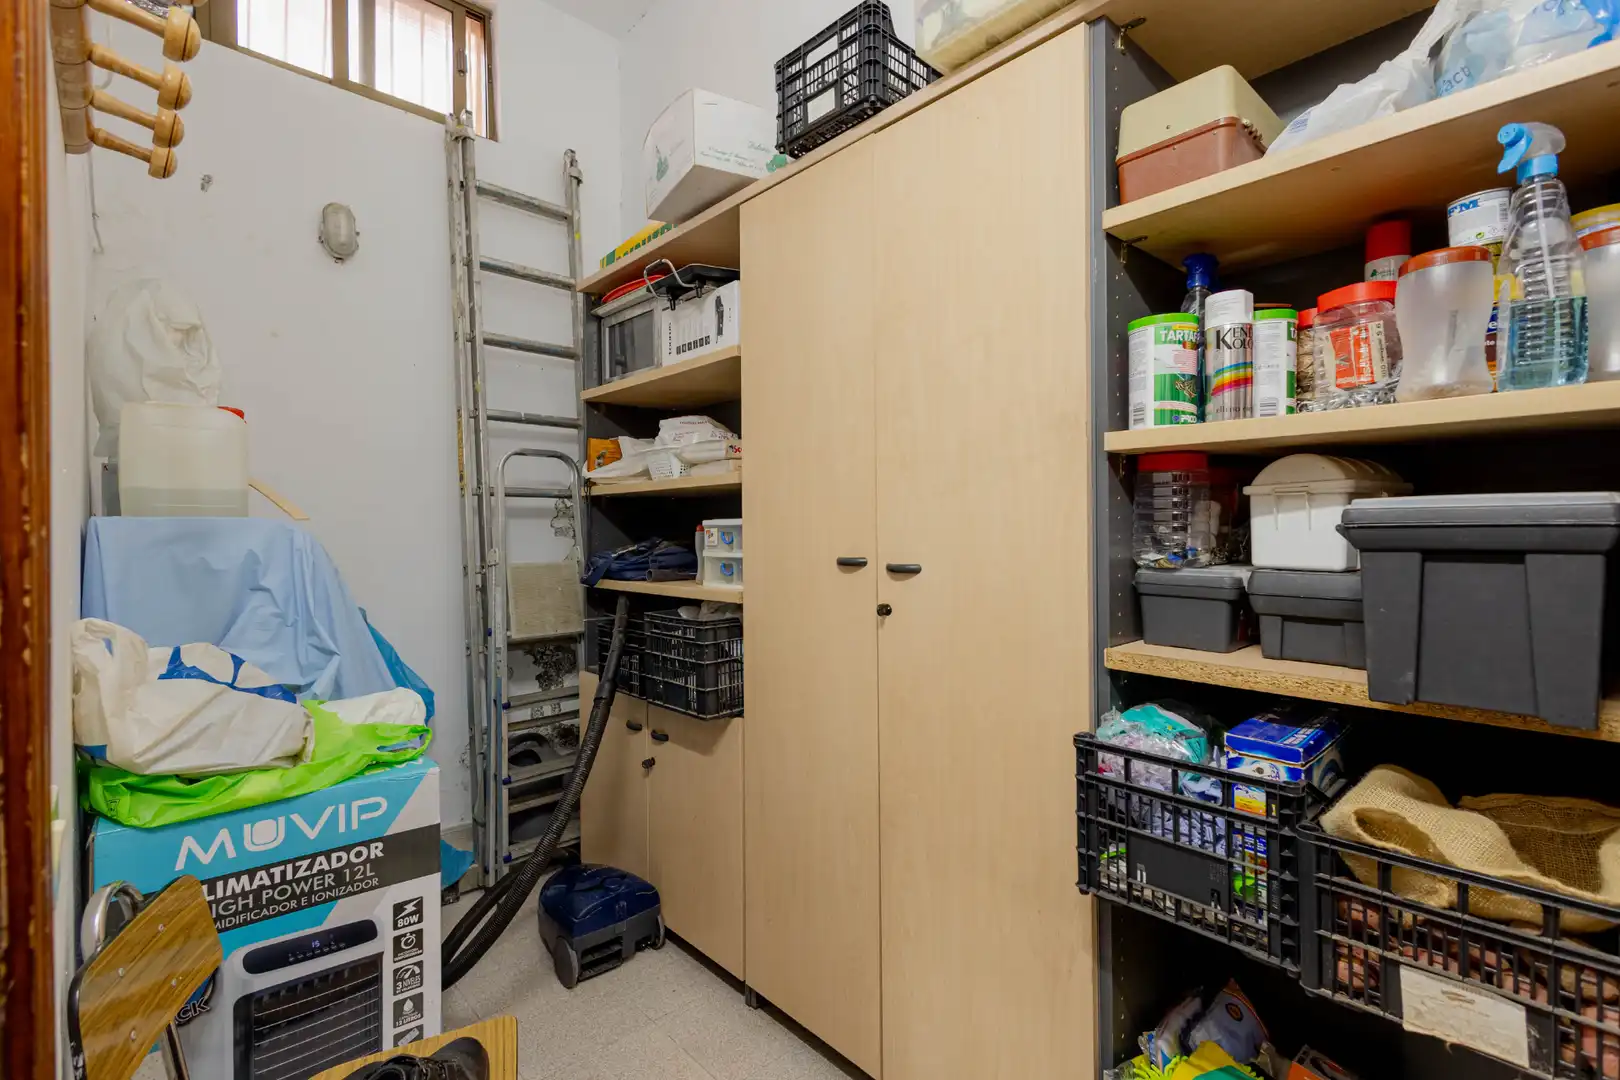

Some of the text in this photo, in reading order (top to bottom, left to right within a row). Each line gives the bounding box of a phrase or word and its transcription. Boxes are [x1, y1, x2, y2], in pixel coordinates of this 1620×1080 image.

[175, 796, 388, 871] MUVIP
[202, 842, 384, 901] LIMATIZADOR
[212, 864, 376, 918] IGH POWER 12L
[215, 877, 379, 929] MIDIFICADOR E IONIZADOR
[397, 914, 420, 928] 80W
[175, 997, 211, 1024] CK
[396, 981, 402, 990] 3
